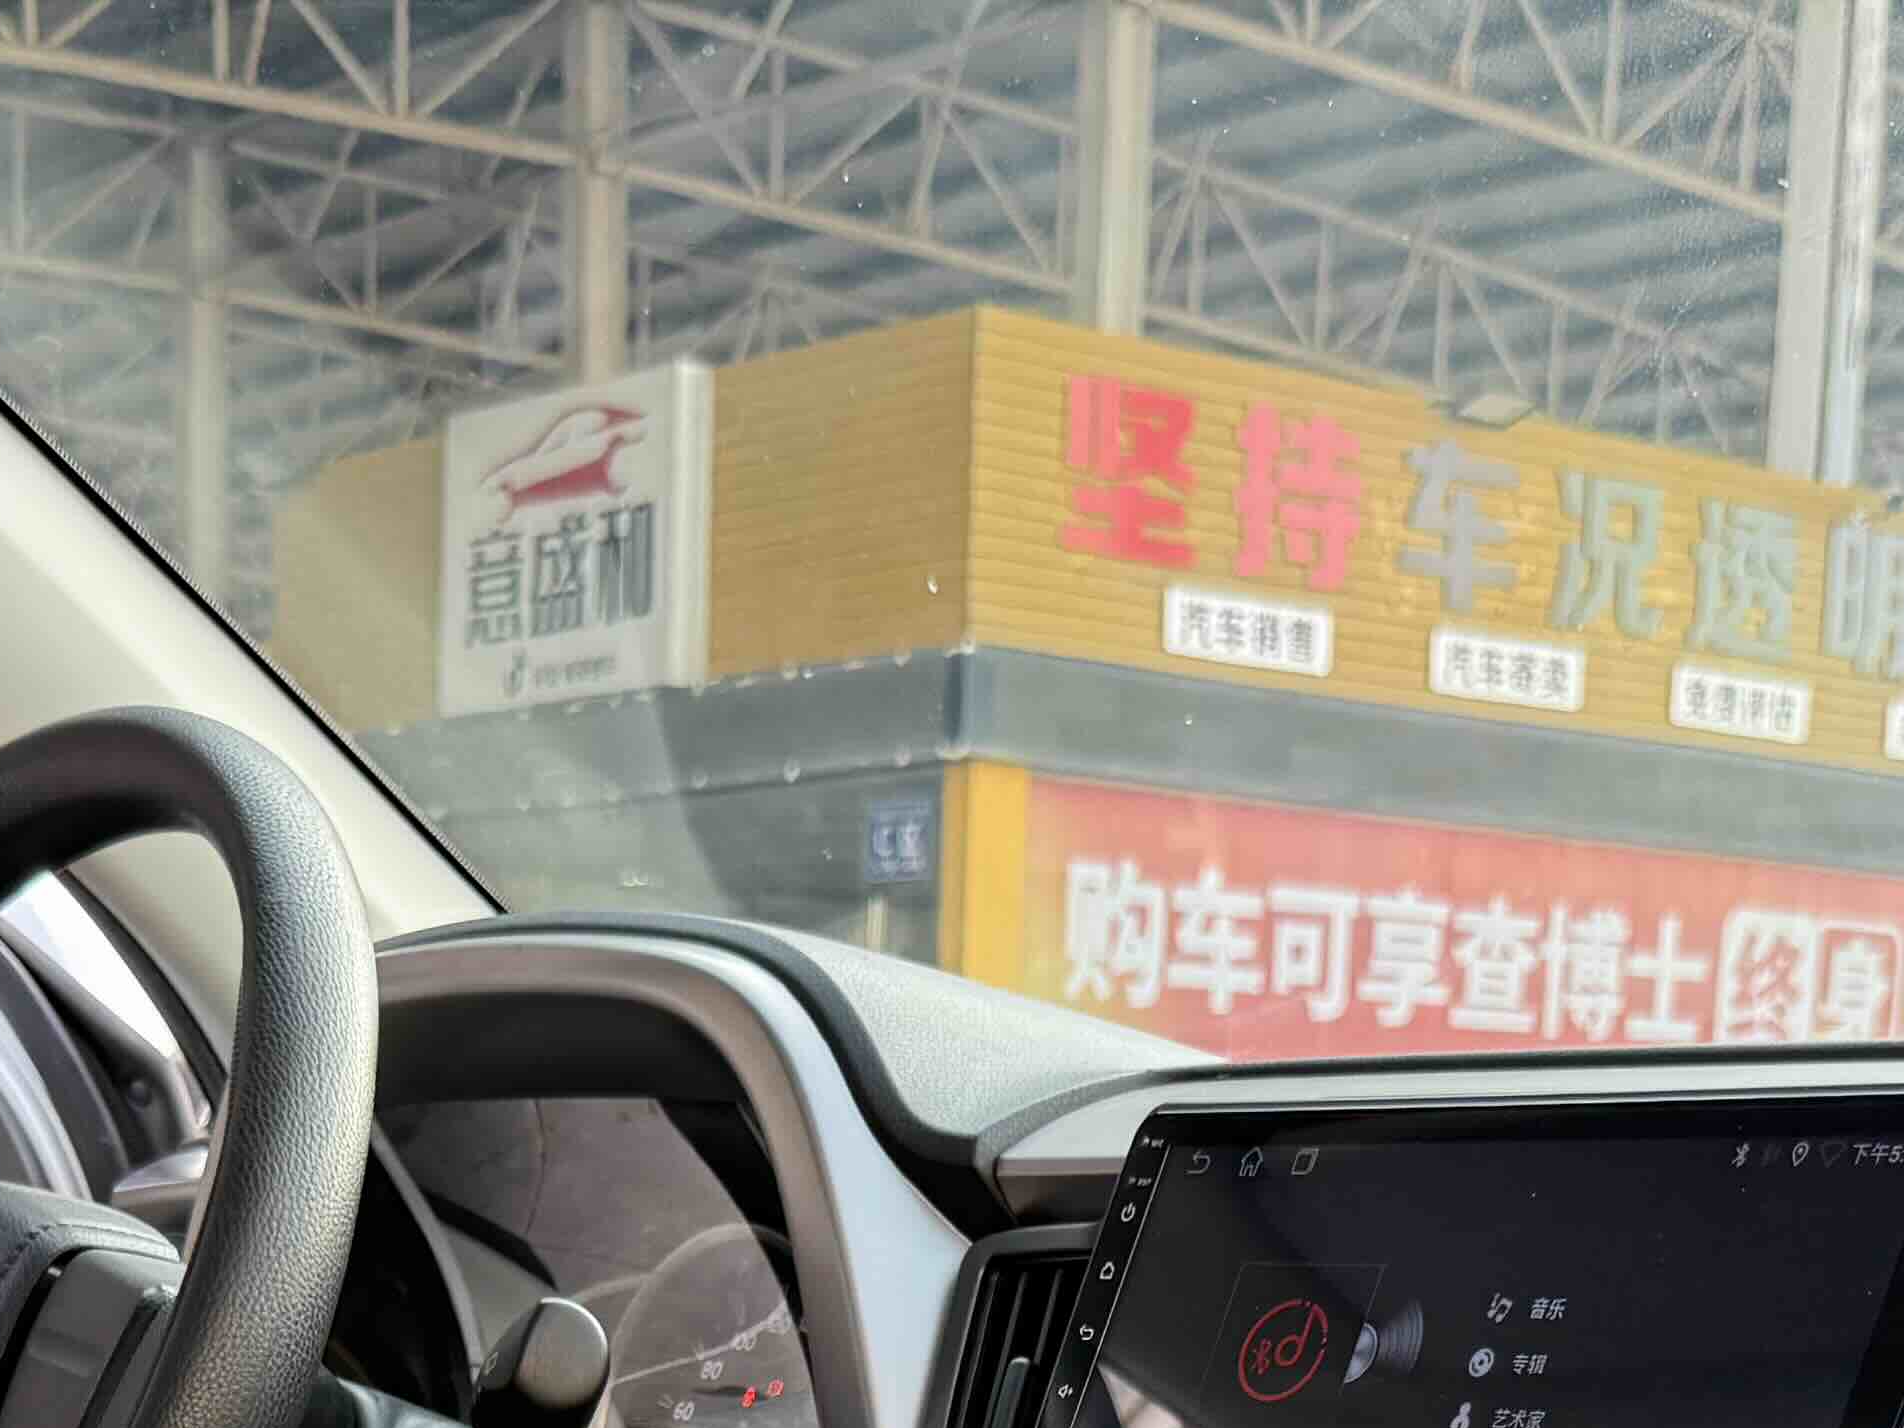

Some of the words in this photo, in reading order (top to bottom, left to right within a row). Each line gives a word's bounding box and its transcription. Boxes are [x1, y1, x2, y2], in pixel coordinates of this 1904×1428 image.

[1529, 1298, 1568, 1320] 音乐
[700, 1359, 724, 1381] 80
[1512, 1353, 1548, 1375] 专辑
[671, 1400, 696, 1422] 60
